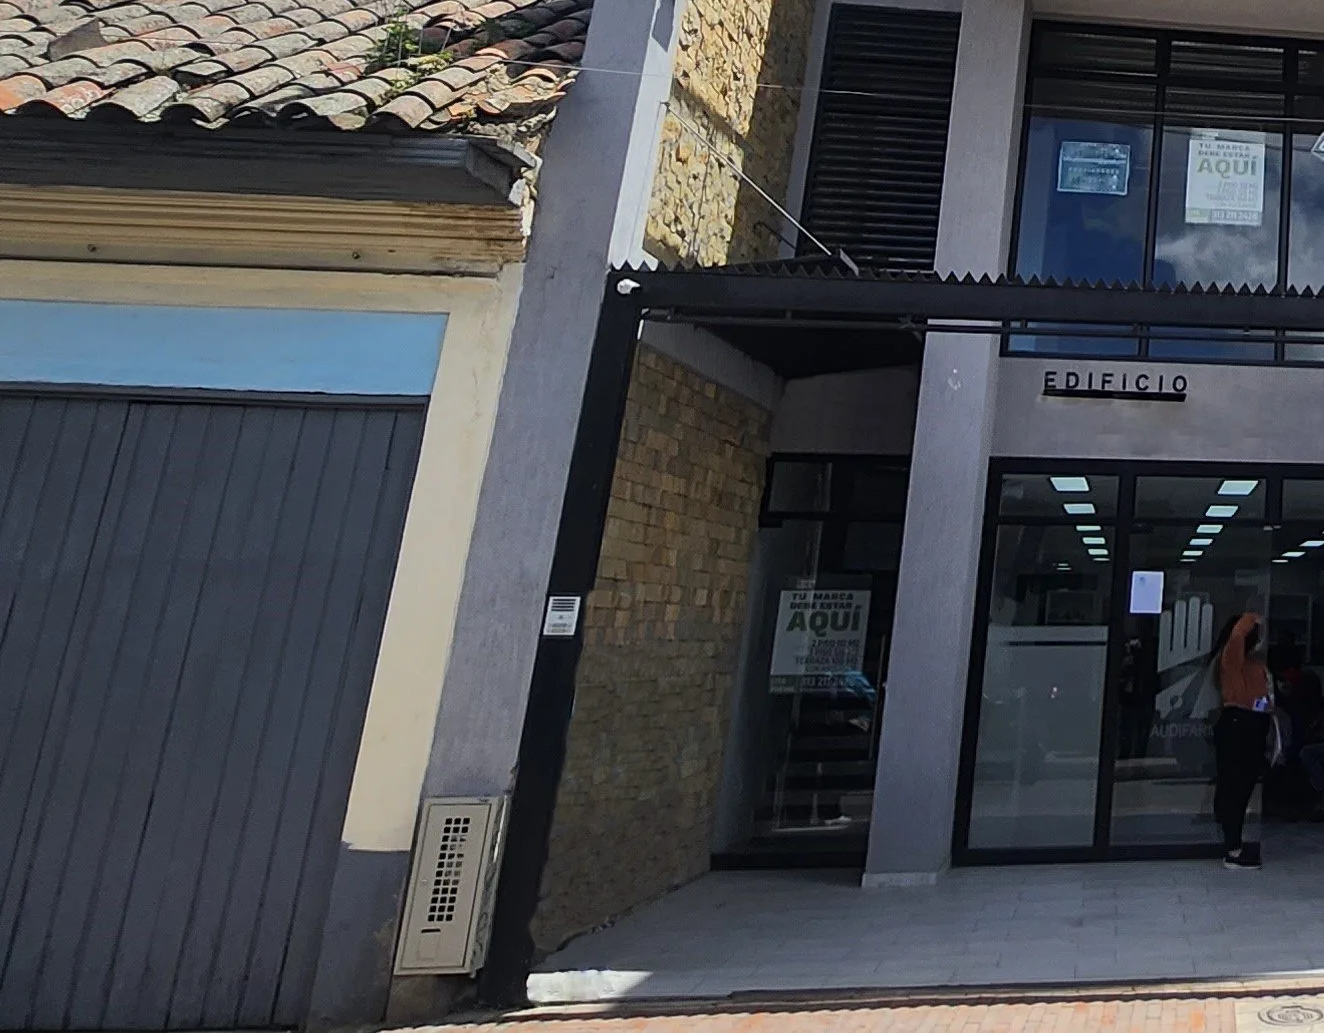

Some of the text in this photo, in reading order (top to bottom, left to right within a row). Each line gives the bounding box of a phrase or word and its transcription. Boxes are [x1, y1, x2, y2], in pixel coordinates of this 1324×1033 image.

[1197, 155, 1258, 179] AQUÍ
[1044, 371, 1187, 392] EDIFICIO
[813, 593, 853, 601] MARCA
[785, 604, 862, 637] AQUÍ
